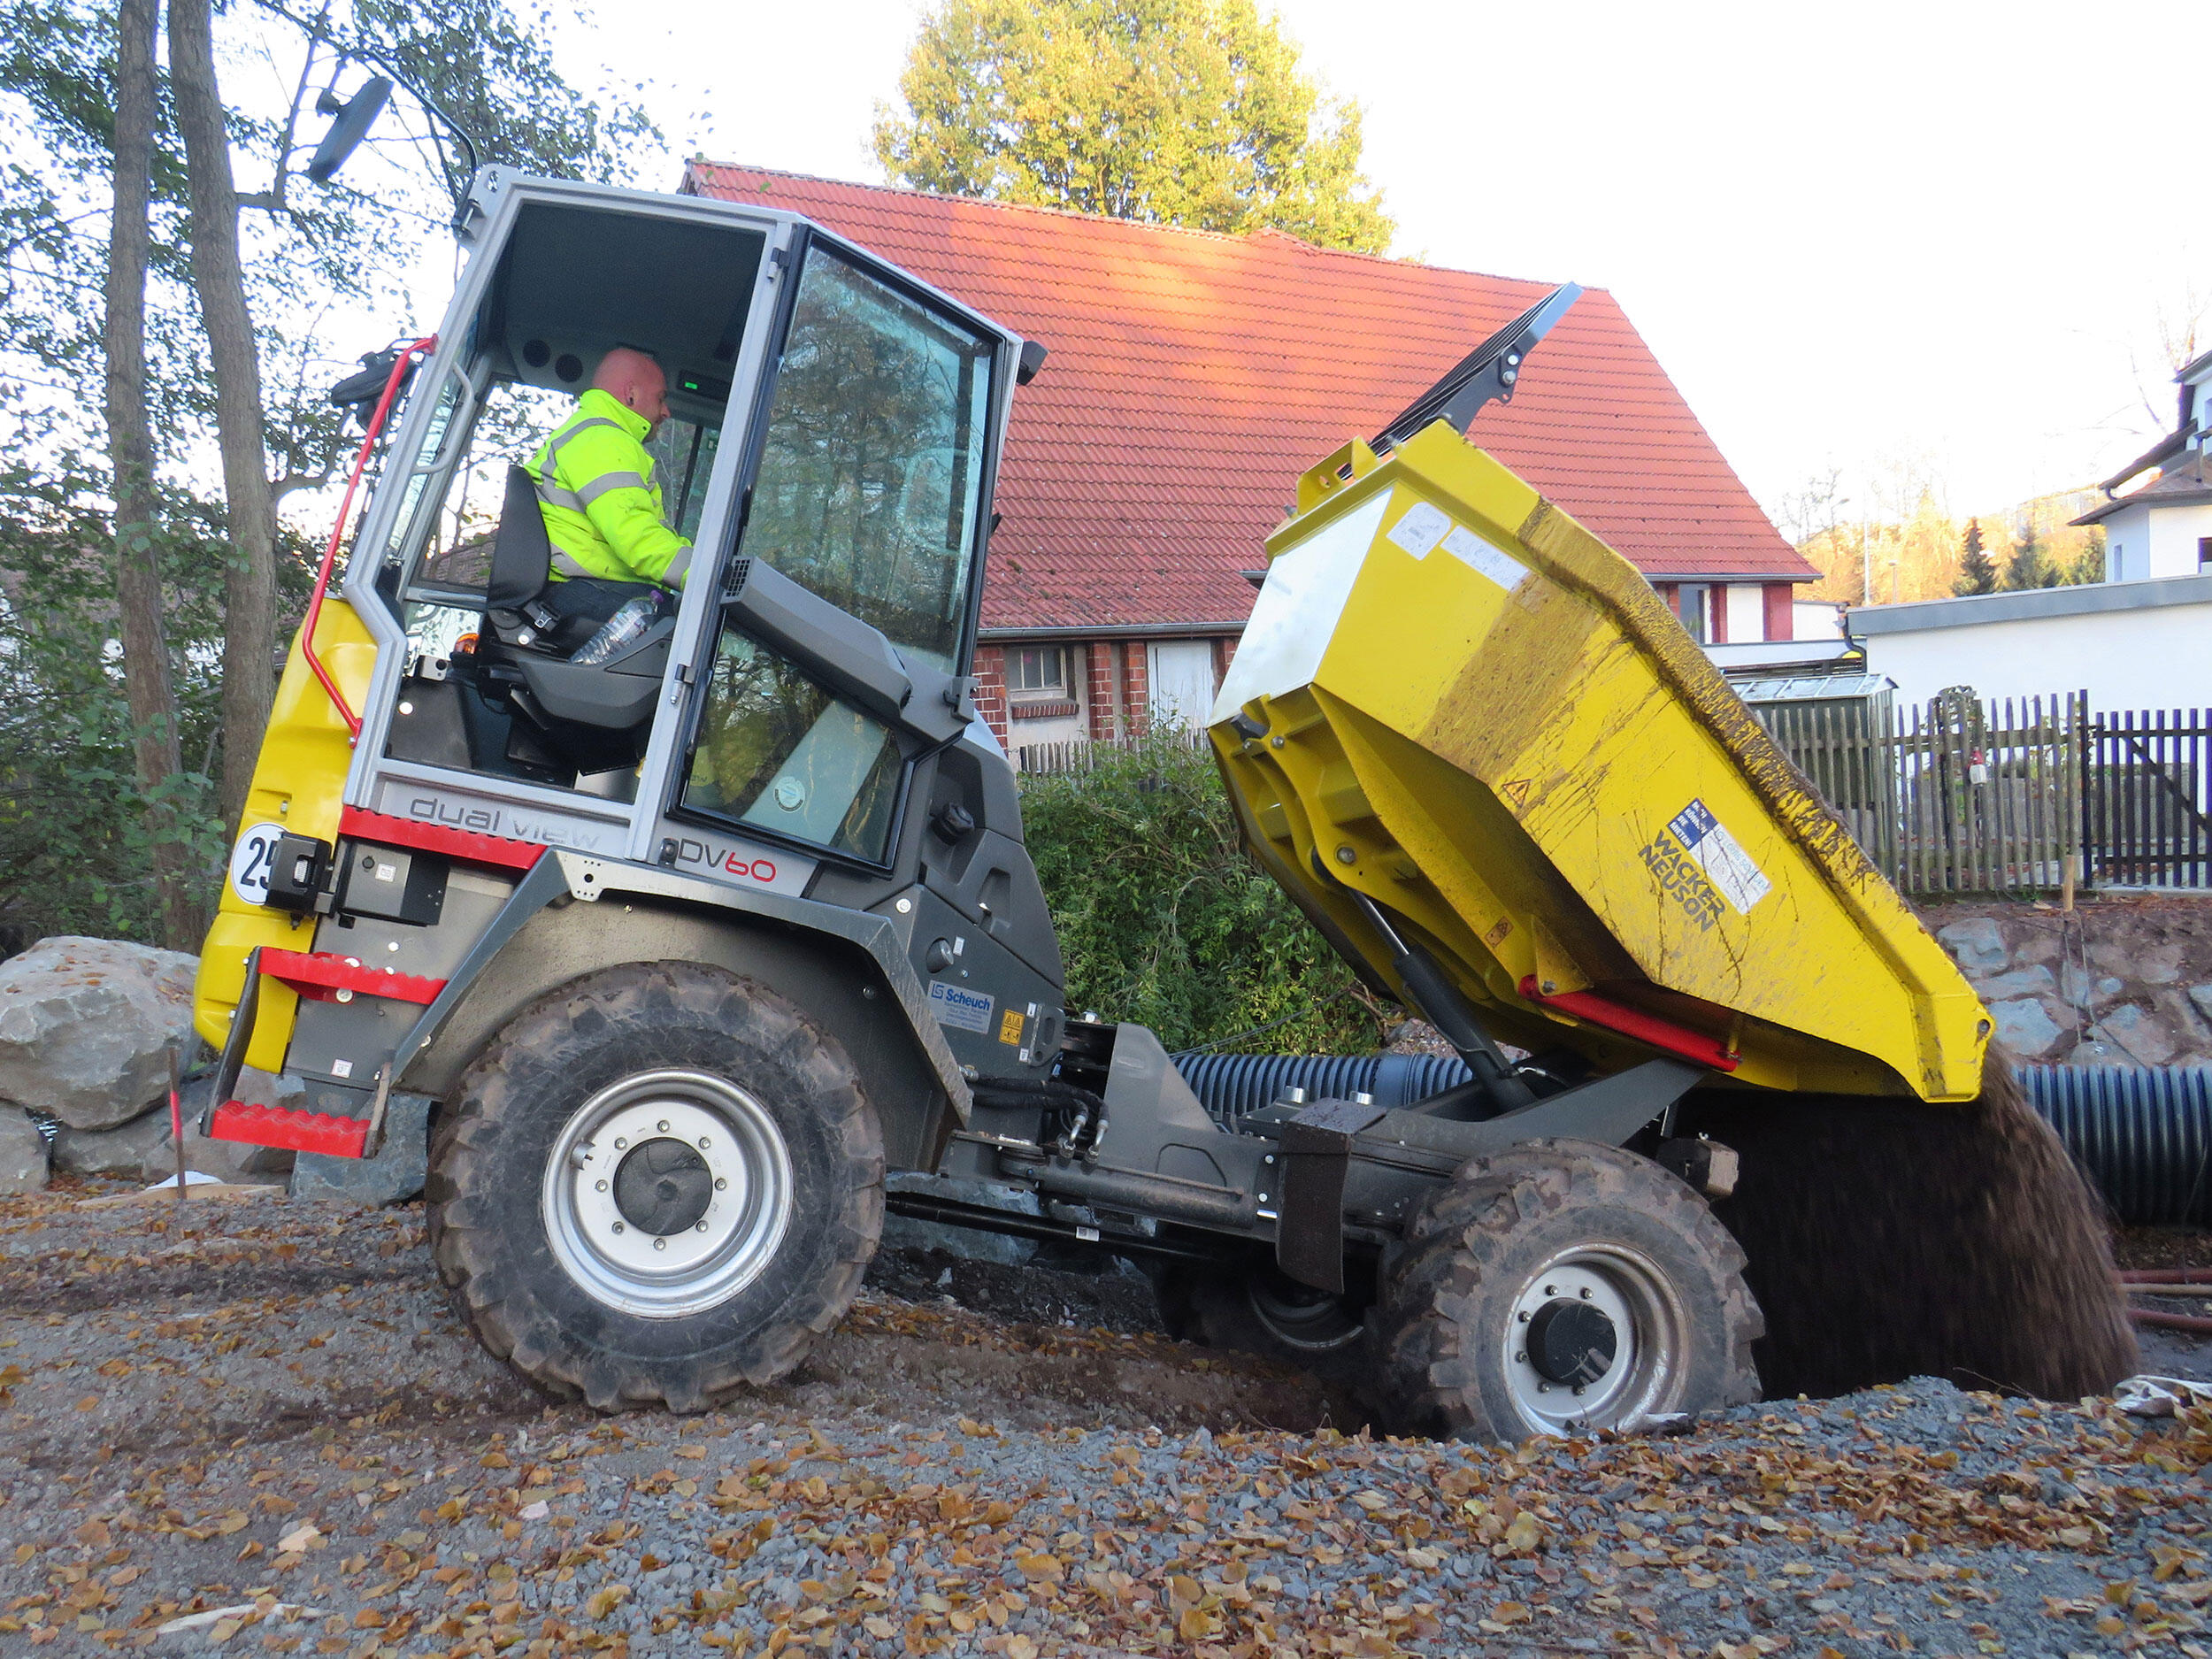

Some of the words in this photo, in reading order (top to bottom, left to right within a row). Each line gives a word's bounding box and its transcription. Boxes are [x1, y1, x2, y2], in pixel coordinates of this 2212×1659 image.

[410, 798, 501, 832] dual
[678, 838, 777, 883] DV60
[1655, 829, 1725, 918] WACKER
[1638, 844, 1716, 933] NEUSON
[946, 988, 990, 1010] Scheuch
